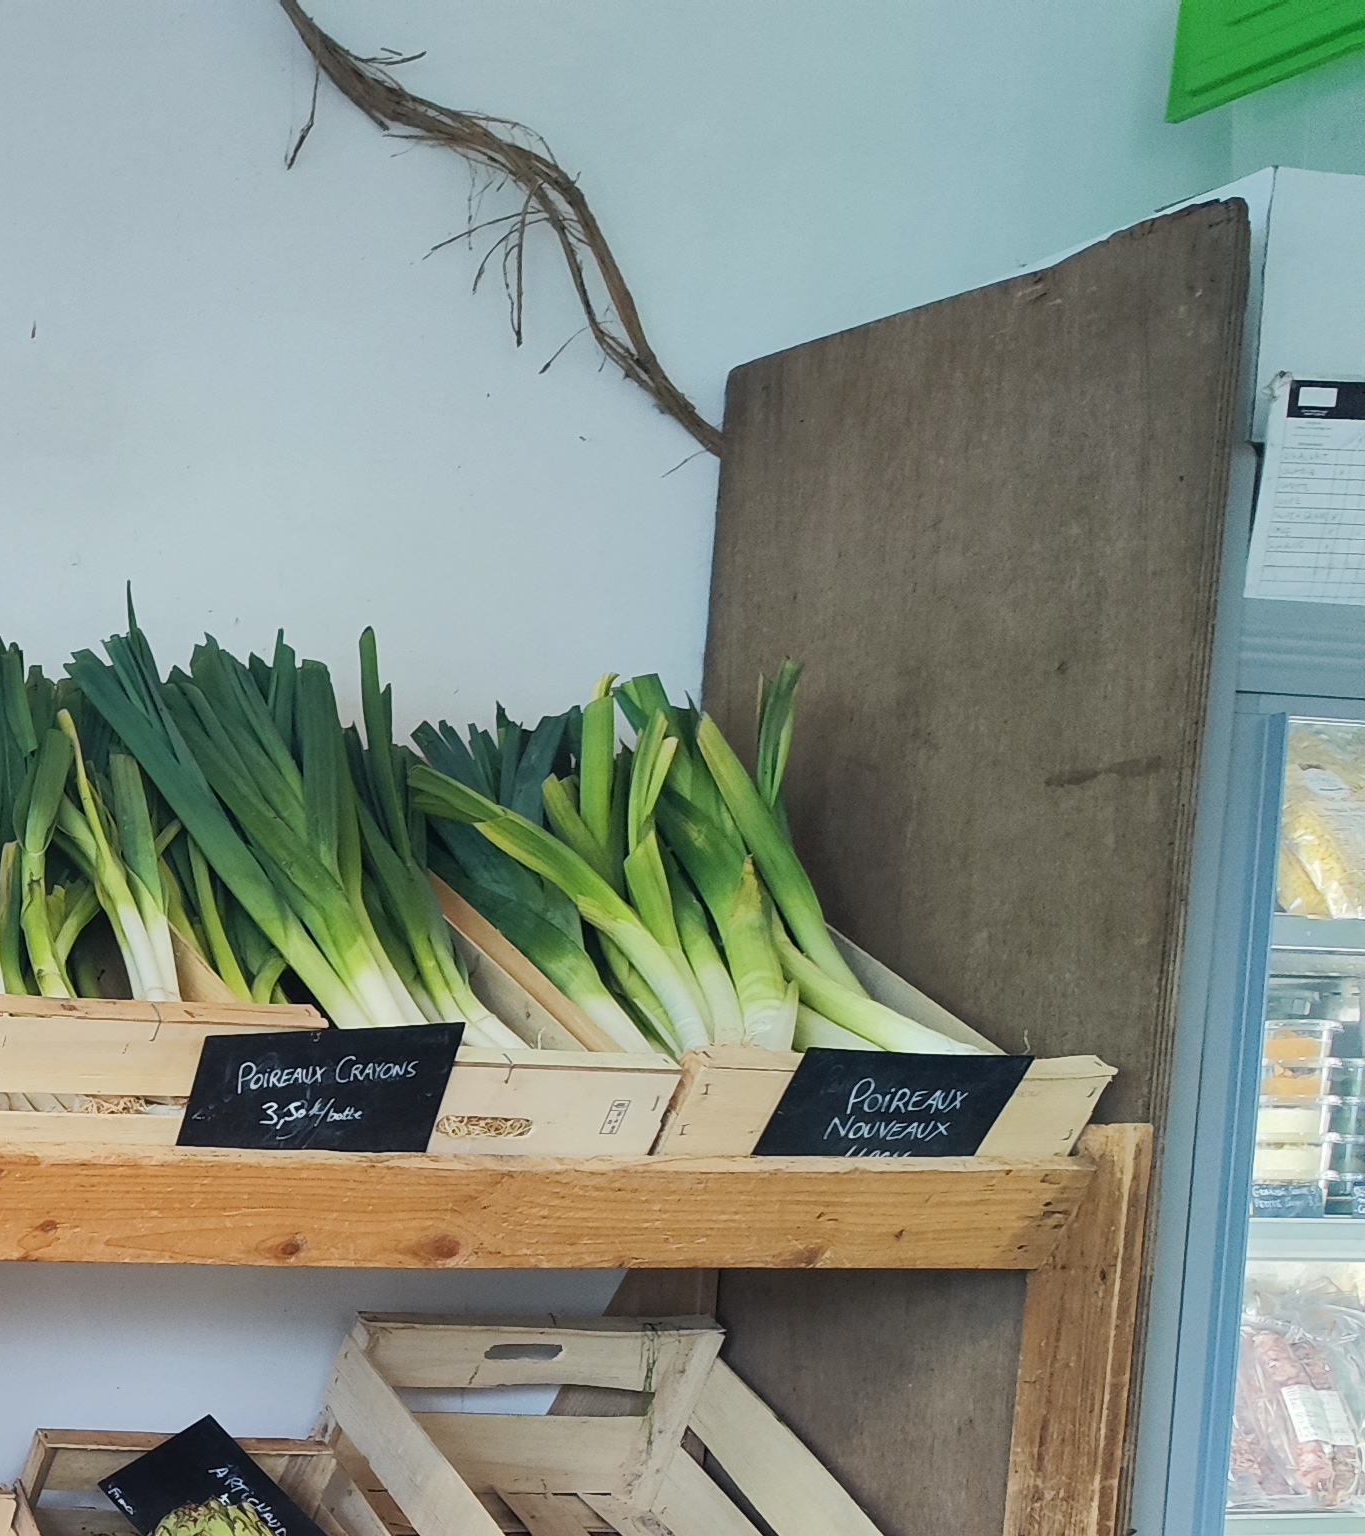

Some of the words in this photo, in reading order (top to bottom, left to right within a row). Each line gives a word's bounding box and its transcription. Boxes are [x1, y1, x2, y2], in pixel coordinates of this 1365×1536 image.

[237, 1061, 327, 1095] POIREAUX
[335, 1056, 419, 1084] CRAYONS
[845, 1077, 969, 1115] POIREAUX
[823, 1115, 952, 1141] NOUVEAUX
